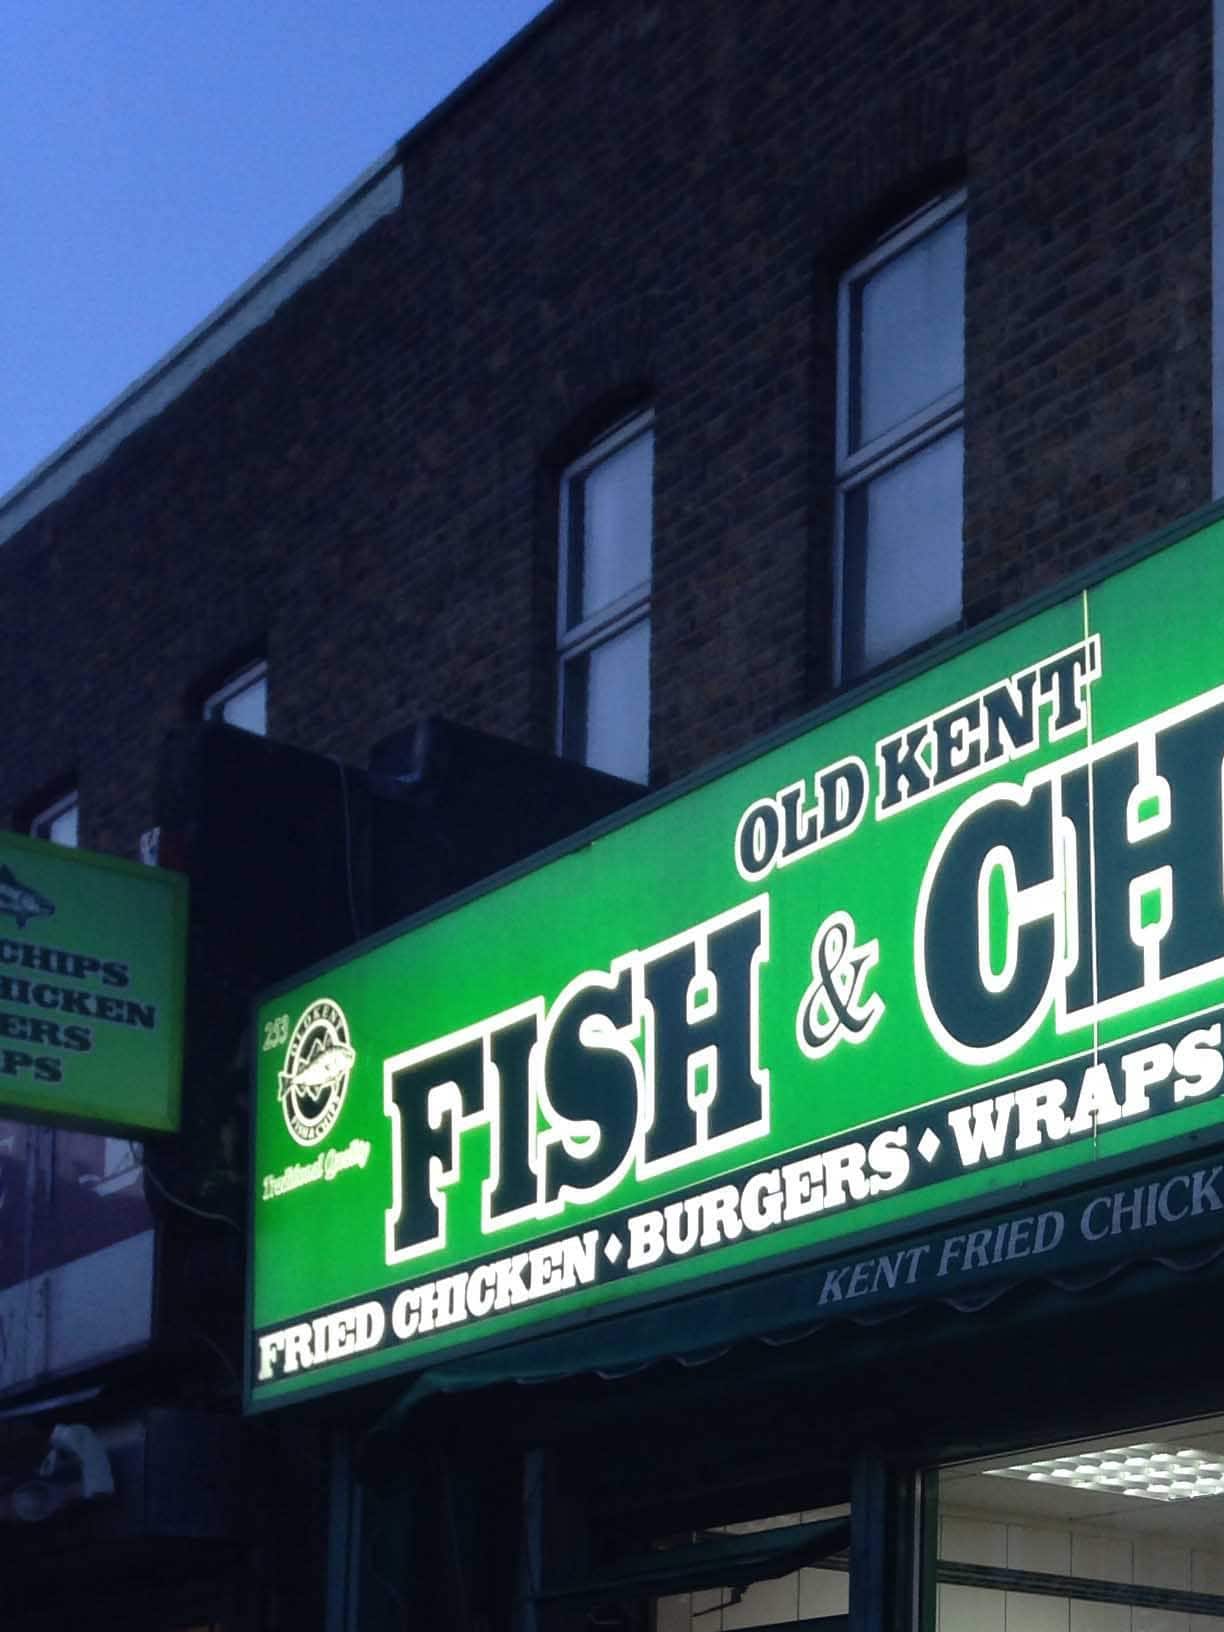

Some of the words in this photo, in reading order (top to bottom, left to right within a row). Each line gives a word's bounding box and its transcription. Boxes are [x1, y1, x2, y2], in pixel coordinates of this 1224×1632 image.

[735, 755, 870, 883] OLD
[874, 636, 1102, 822] KENT
[0, 937, 130, 989] CHIPS
[383, 892, 771, 1266] FISH
[795, 909, 887, 1060] &
[257, 1300, 387, 1381] FRIED
[392, 1230, 600, 1340] CHICKEN
[626, 1124, 911, 1269] BURGERS
[947, 1022, 1224, 1168] WRAPS
[817, 1244, 931, 1306] KENT
[935, 1209, 1065, 1278] FRIED
